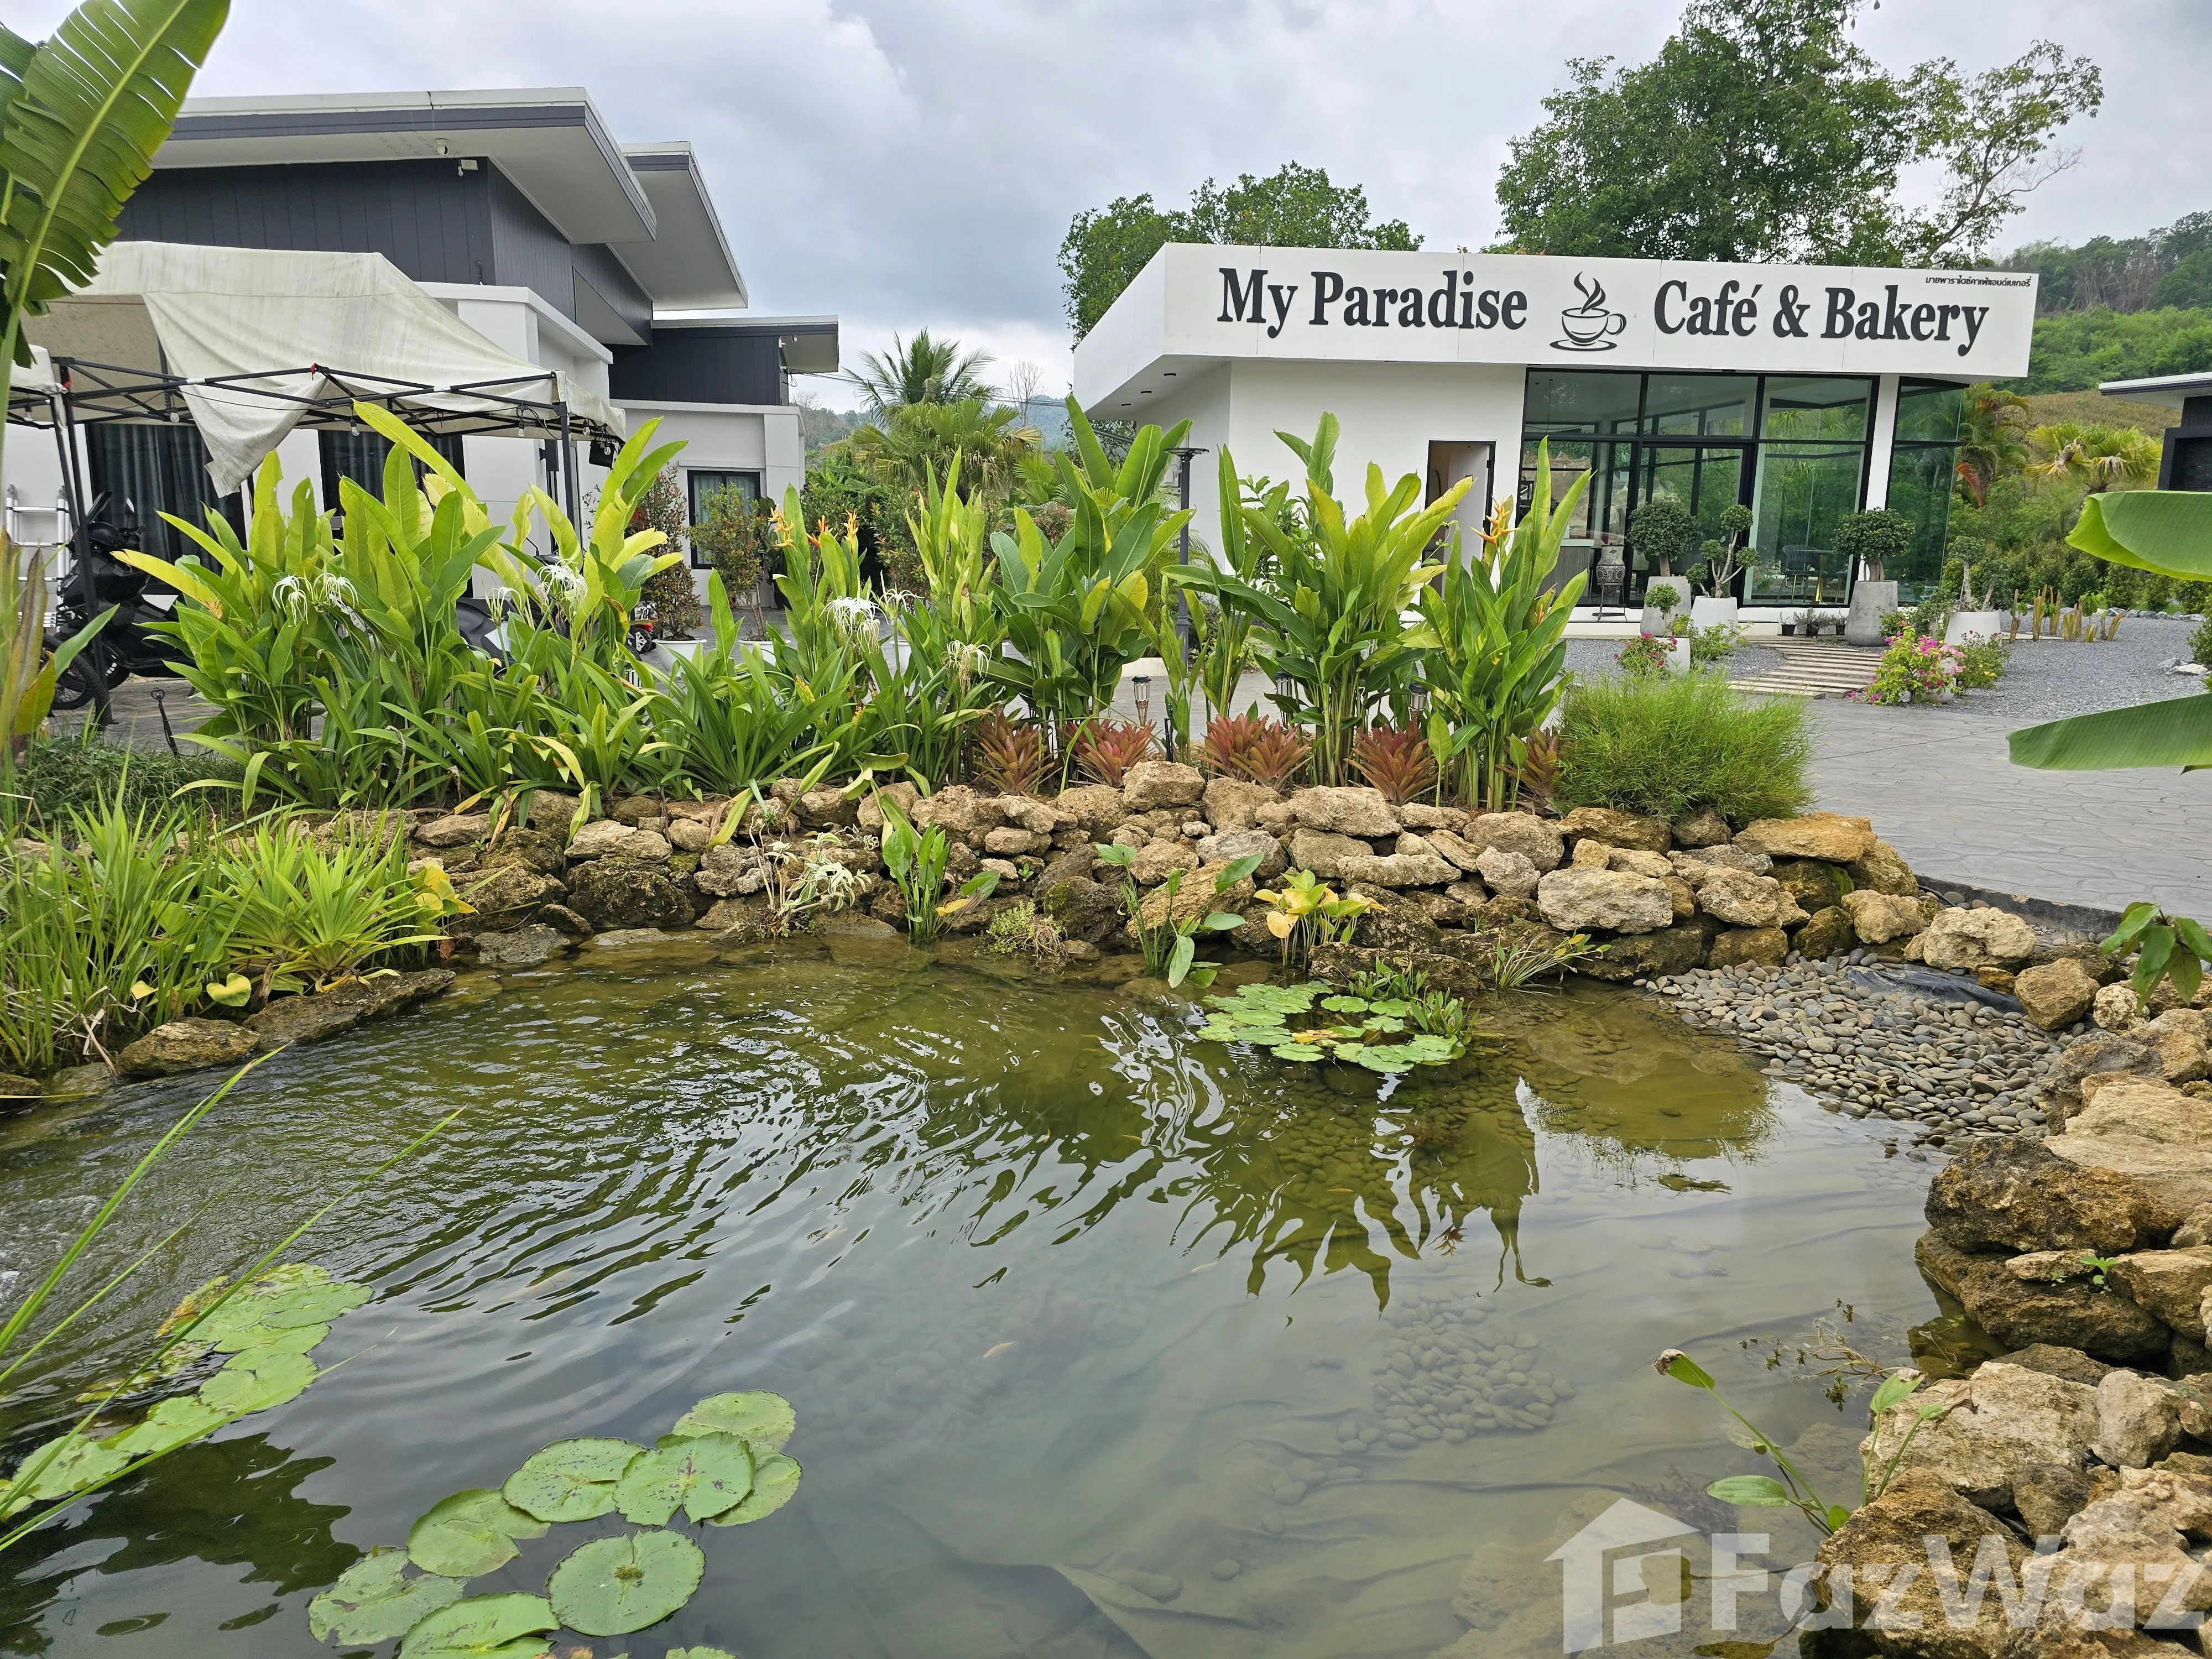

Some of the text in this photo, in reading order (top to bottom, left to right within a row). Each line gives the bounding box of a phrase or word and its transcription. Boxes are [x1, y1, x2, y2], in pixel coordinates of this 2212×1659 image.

[1217, 268, 1990, 357] My Paradise Café & Bakery
